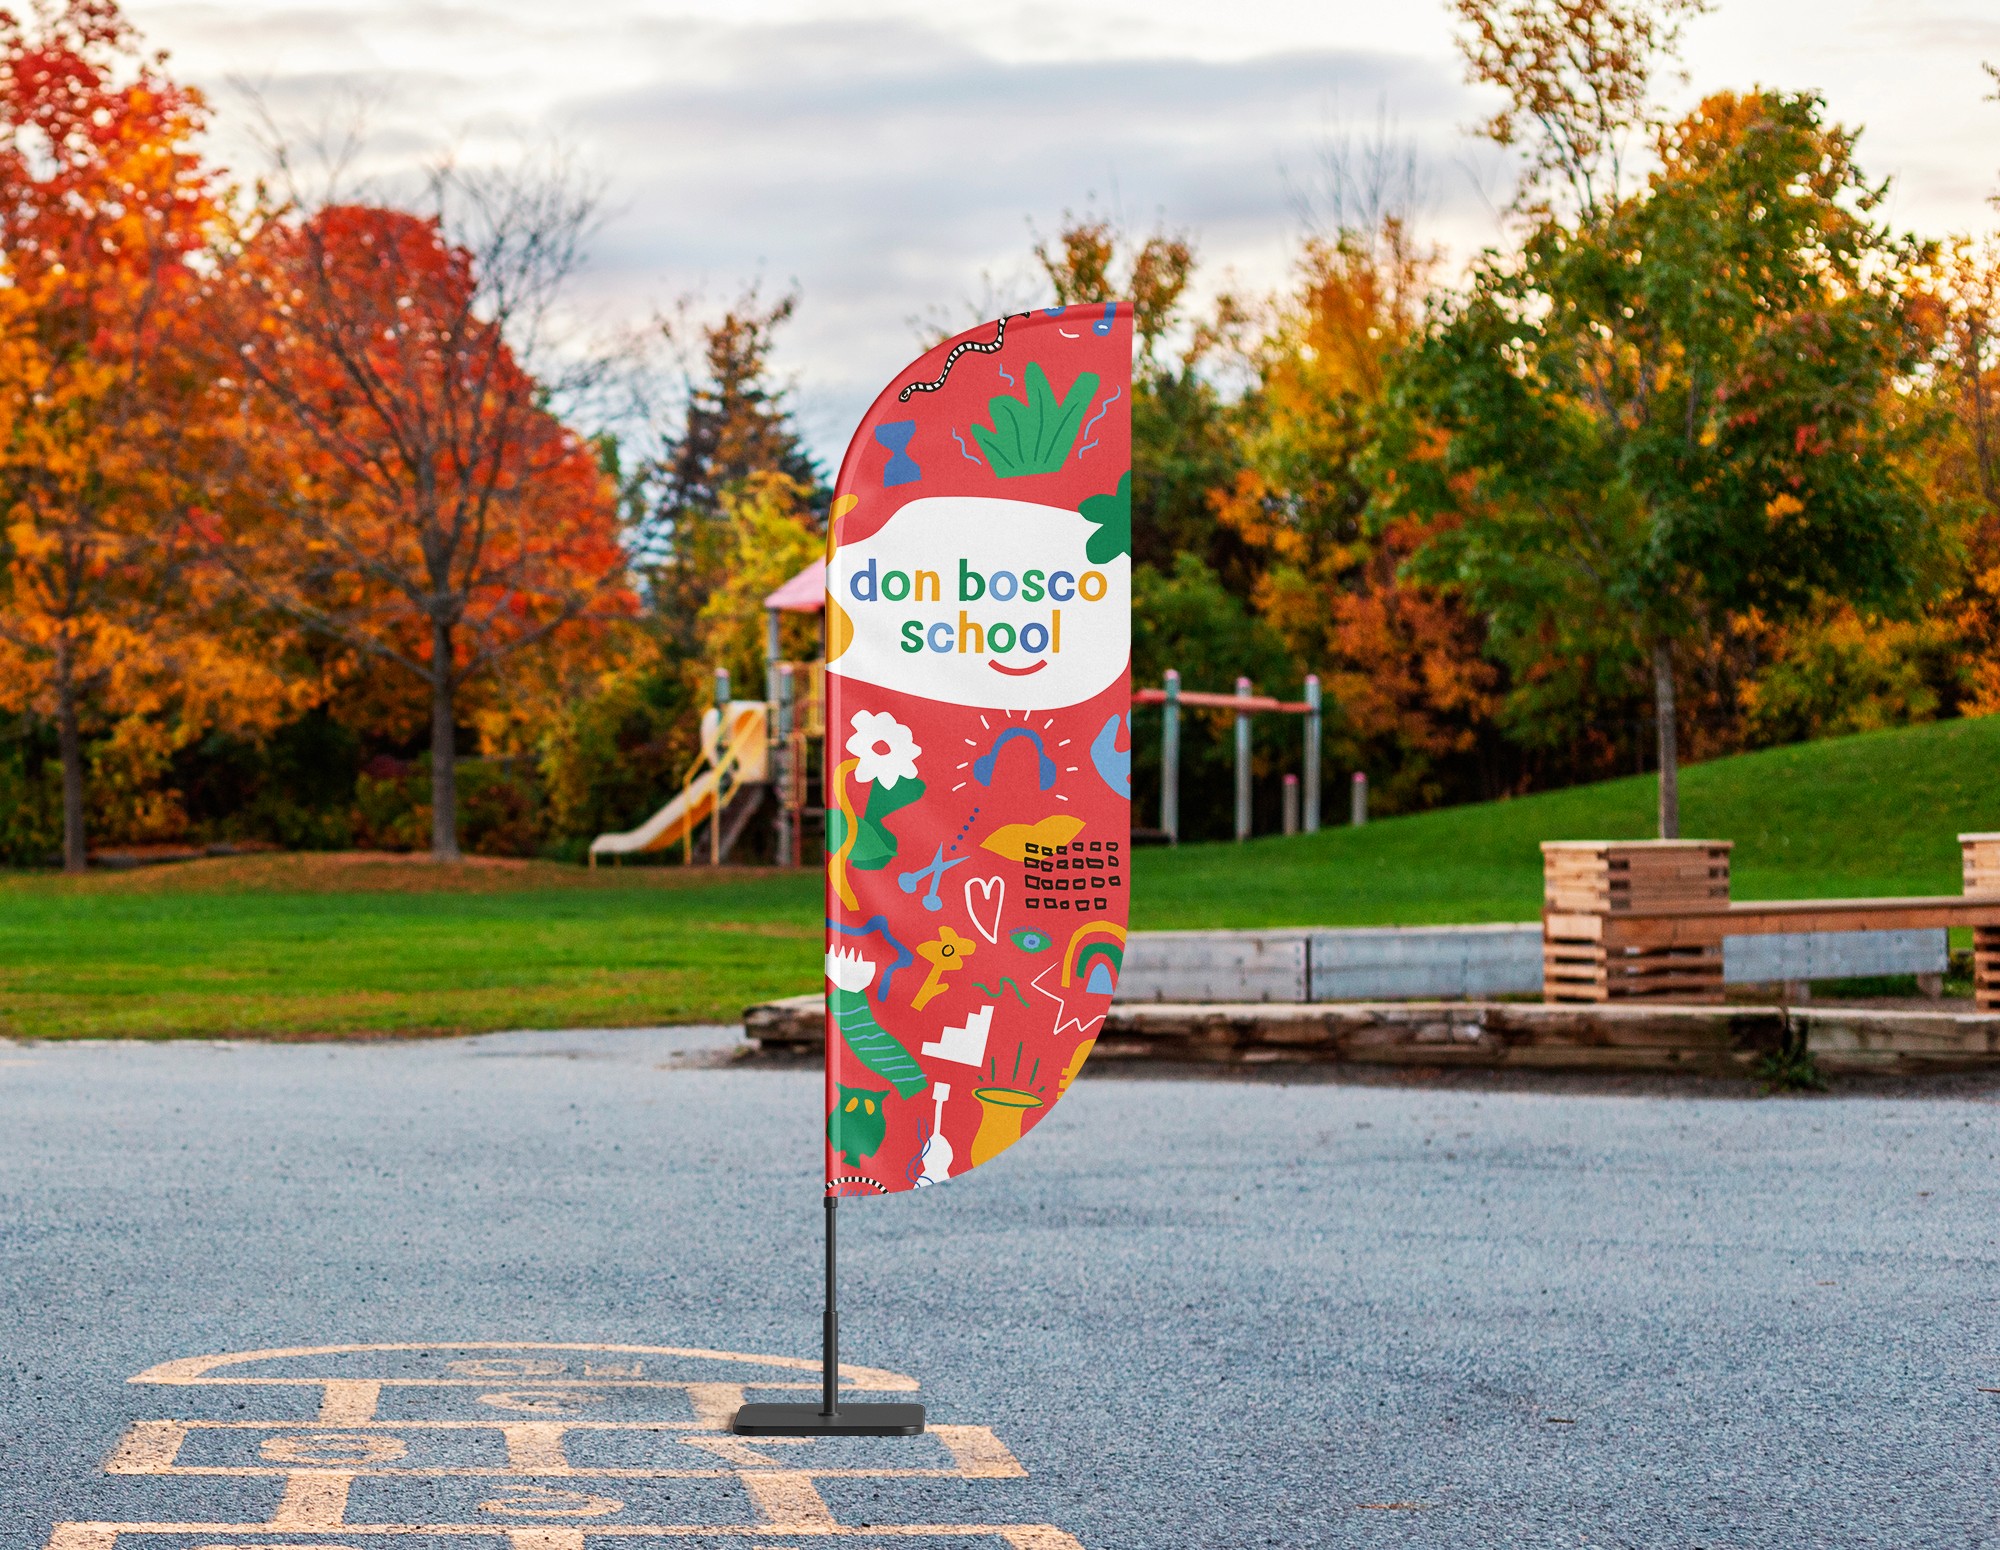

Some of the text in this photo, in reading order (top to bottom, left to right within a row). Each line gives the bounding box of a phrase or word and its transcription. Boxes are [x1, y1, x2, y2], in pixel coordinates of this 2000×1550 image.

[850, 558, 1108, 602] don bosco
[900, 609, 1061, 654] school
